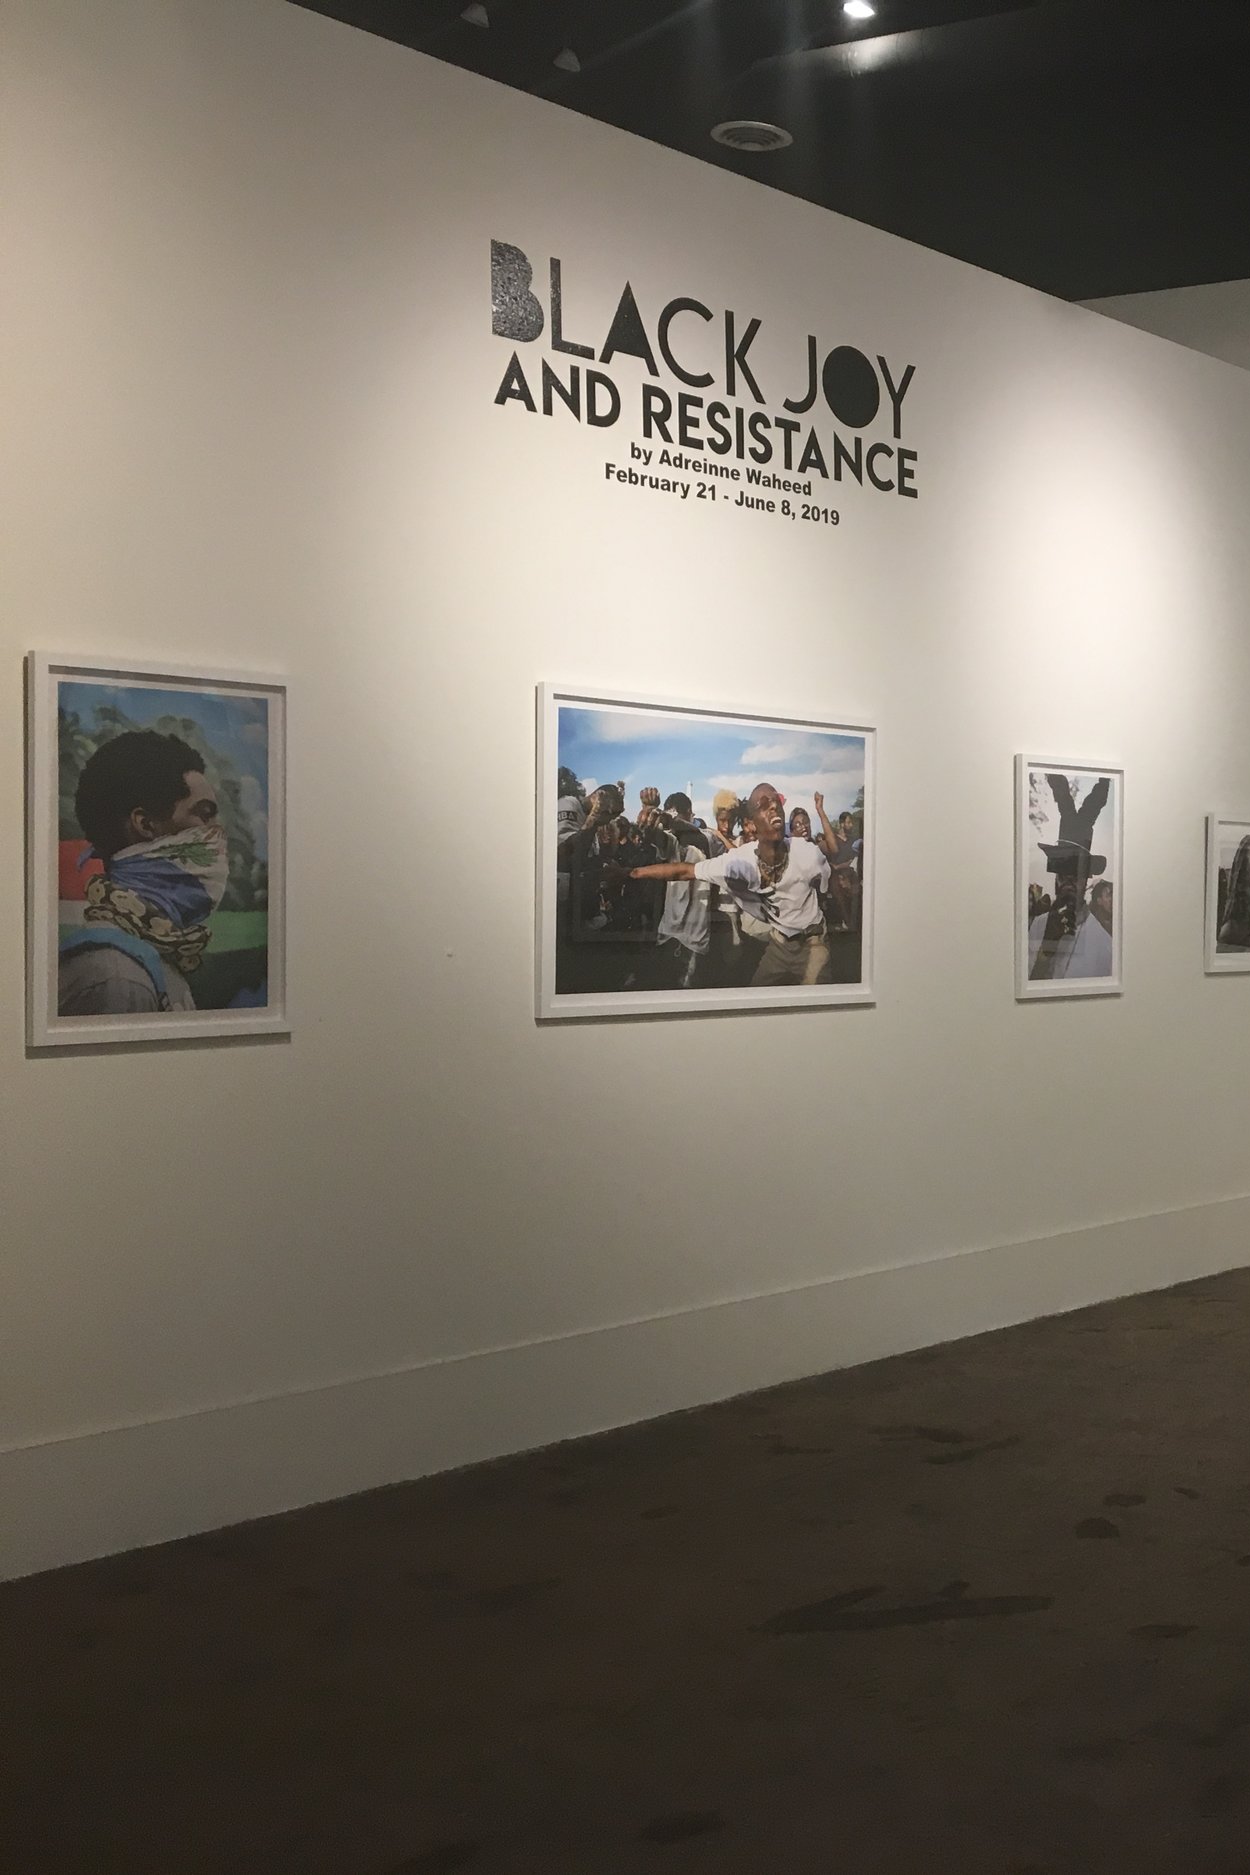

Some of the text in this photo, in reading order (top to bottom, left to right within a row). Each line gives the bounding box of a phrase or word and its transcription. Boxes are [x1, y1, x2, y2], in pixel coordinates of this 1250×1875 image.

[490, 239, 917, 440] BLACK JOY
[493, 350, 919, 500] AND RESISTANCE
[630, 442, 812, 497] by Adreinne Waheed
[605, 462, 691, 500] February
[696, 482, 716, 502] 21
[734, 490, 776, 513] June
[780, 500, 796, 521] 8,
[800, 504, 840, 526] 2019
